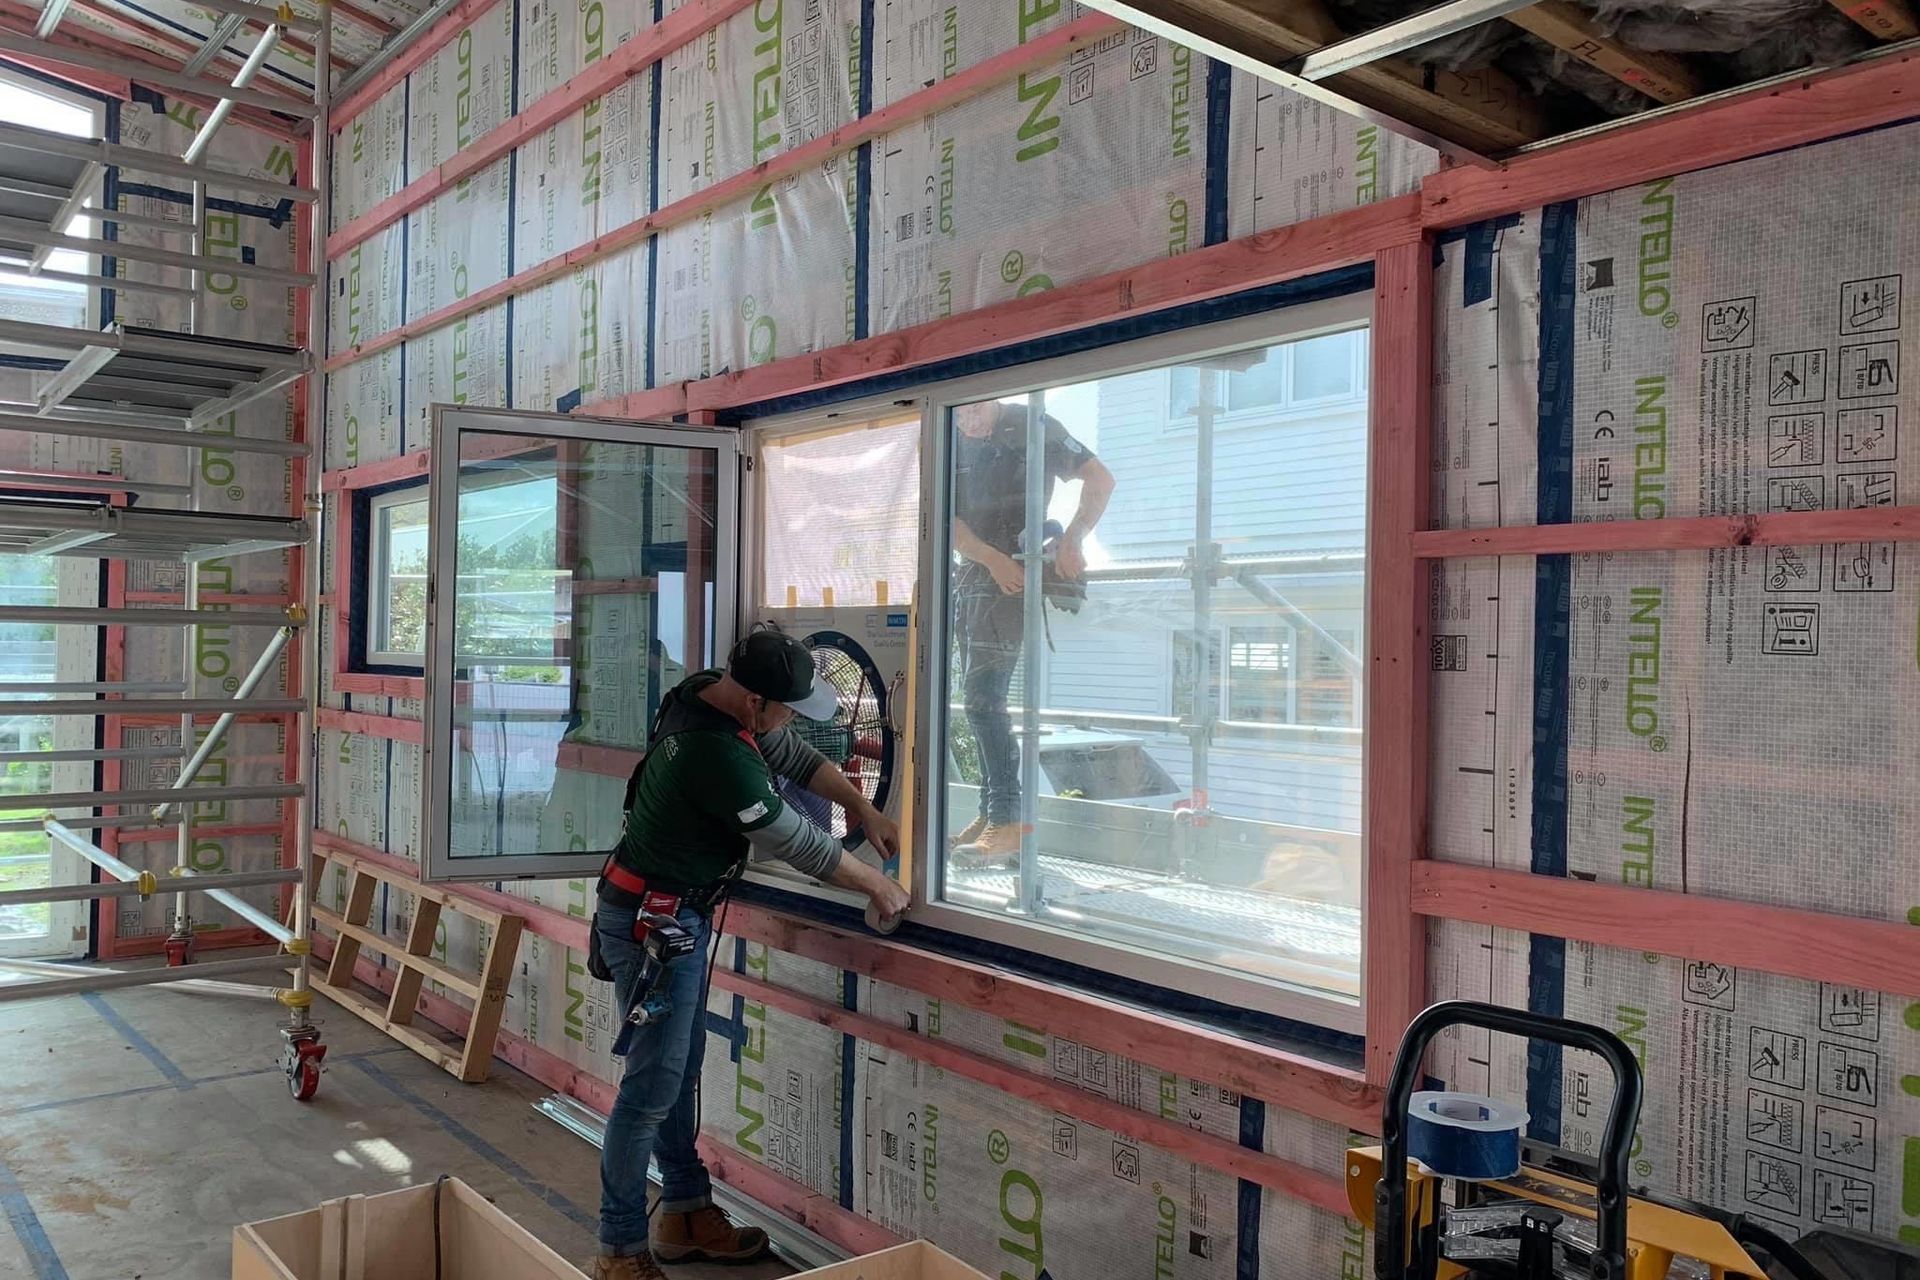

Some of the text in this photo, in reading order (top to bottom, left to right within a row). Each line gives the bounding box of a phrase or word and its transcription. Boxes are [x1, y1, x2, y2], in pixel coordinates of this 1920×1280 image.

[1356, 127, 1378, 206] INTE
[1635, 178, 1681, 330] NTELLO®
[1622, 795, 1656, 890] INTE
